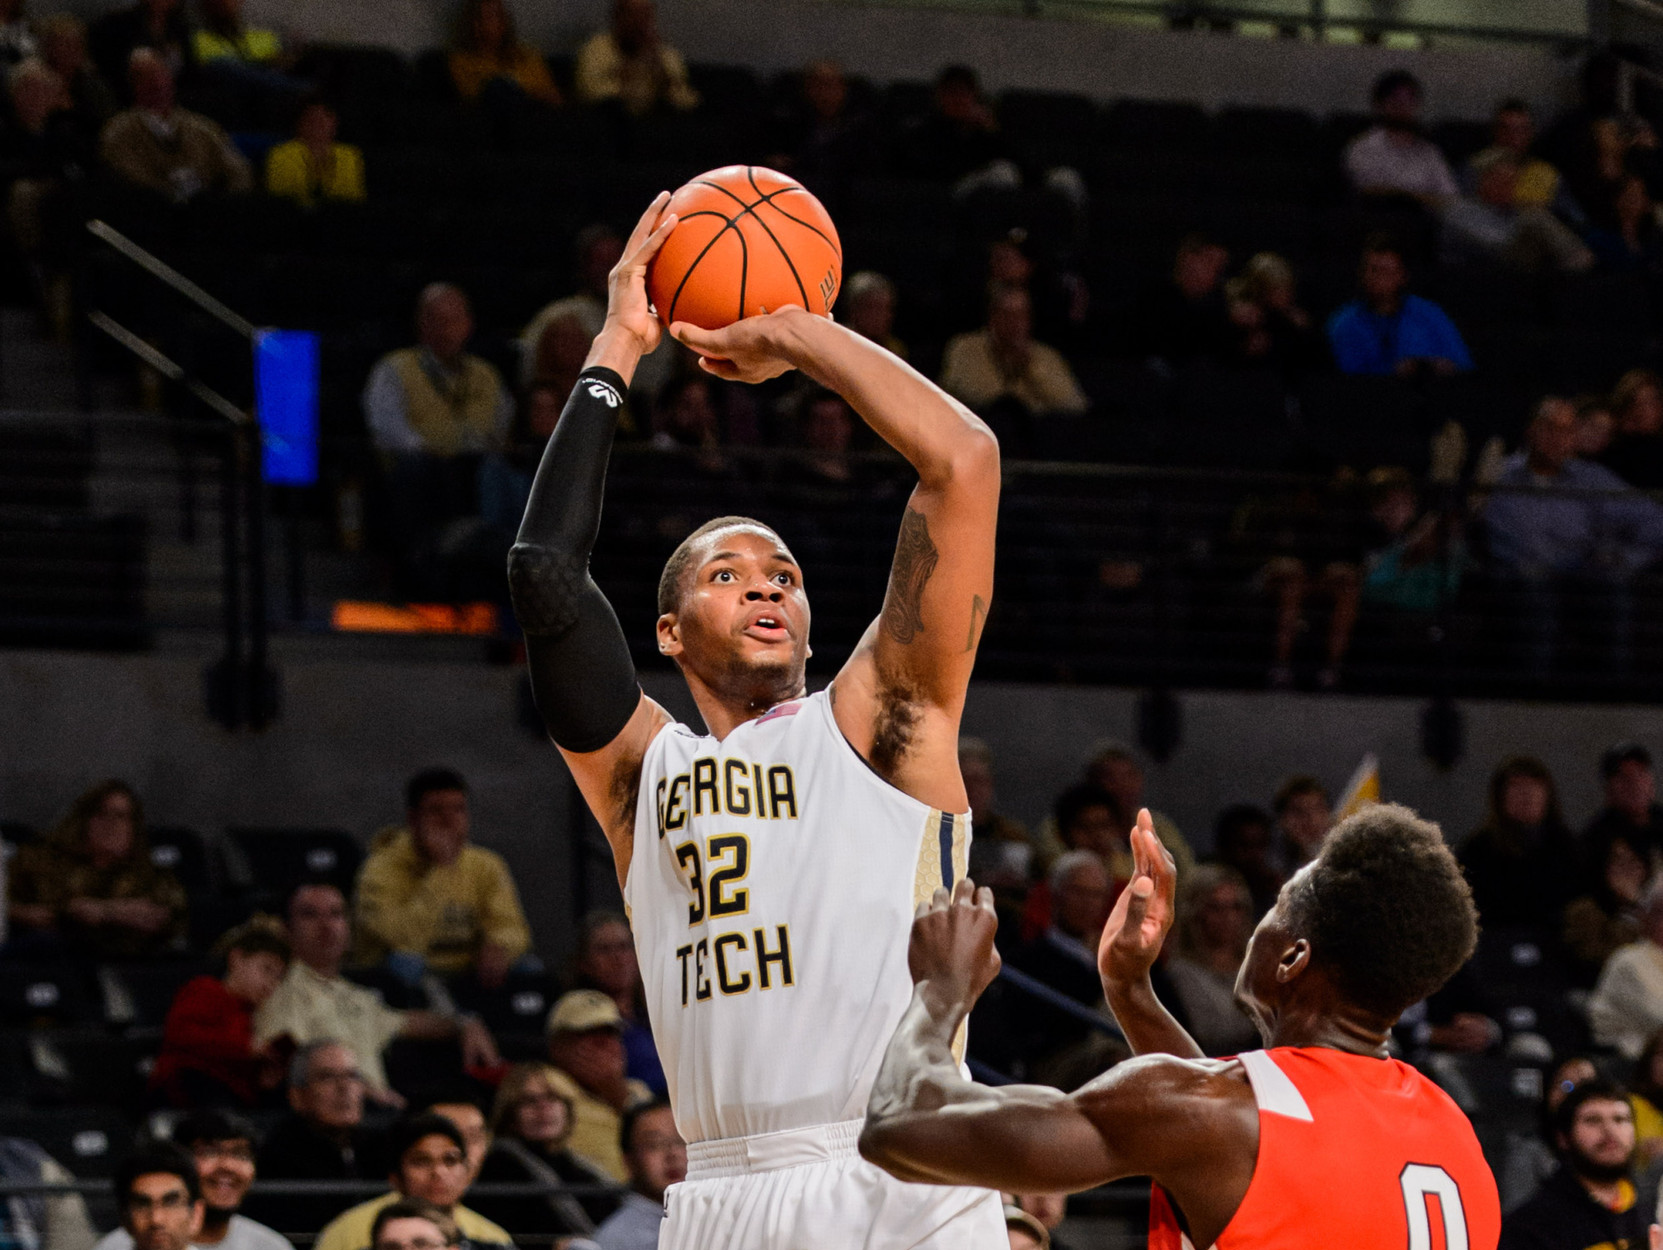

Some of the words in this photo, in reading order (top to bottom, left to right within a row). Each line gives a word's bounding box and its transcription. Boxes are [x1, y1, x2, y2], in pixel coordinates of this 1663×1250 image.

[655, 756, 799, 841] GEORGIA
[675, 832, 752, 928] 32
[675, 923, 796, 1008] TECH
